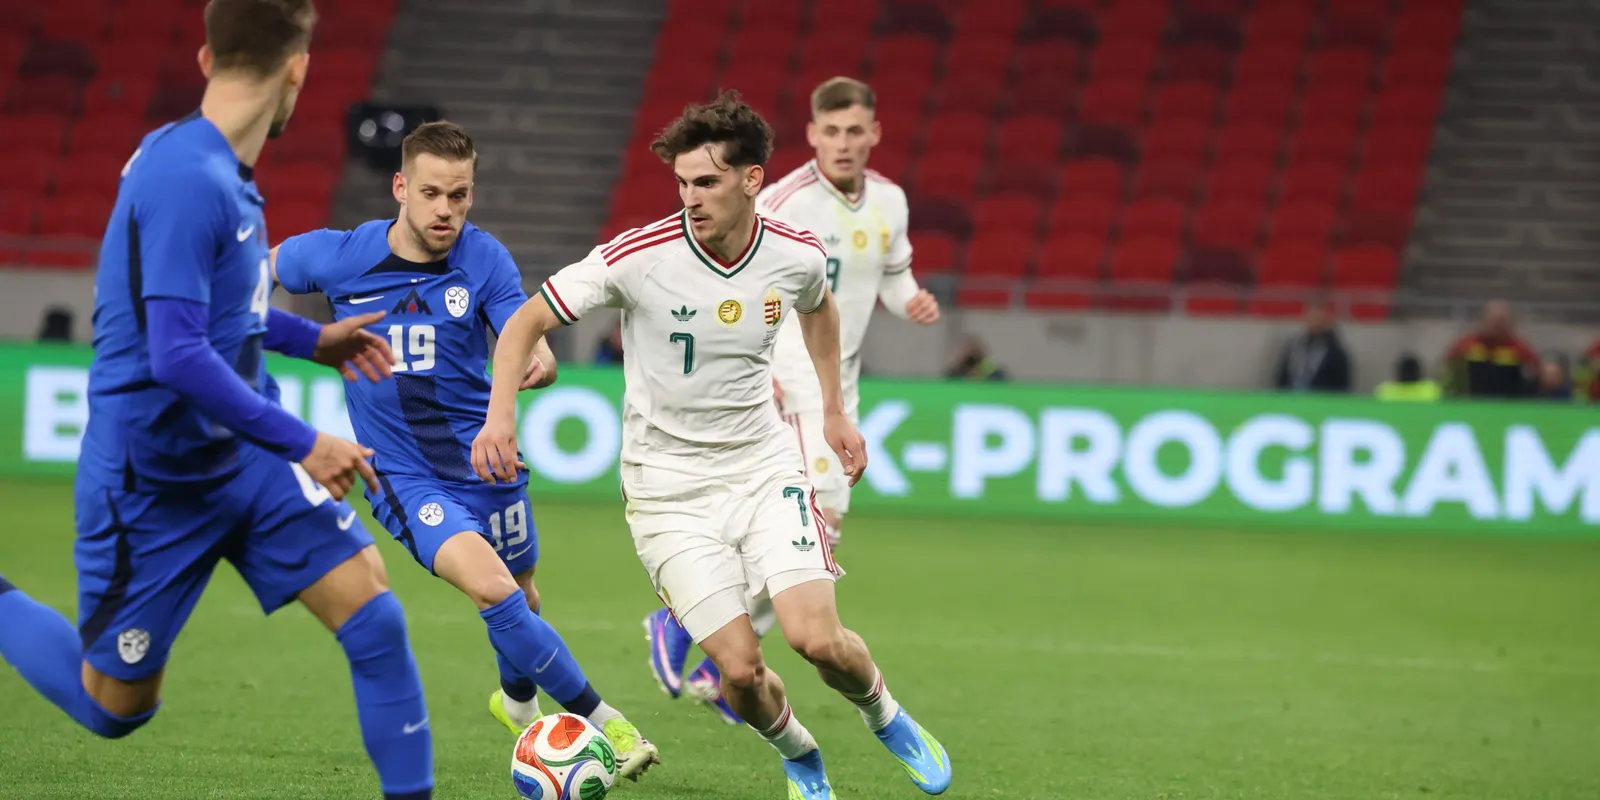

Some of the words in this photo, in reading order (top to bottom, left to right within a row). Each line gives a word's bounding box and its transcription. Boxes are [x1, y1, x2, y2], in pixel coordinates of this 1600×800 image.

[250, 259, 269, 322] 4
[388, 324, 435, 372] 19
[669, 332, 695, 375] 7
[489, 500, 528, 552] 19
[782, 486, 808, 527] 7
